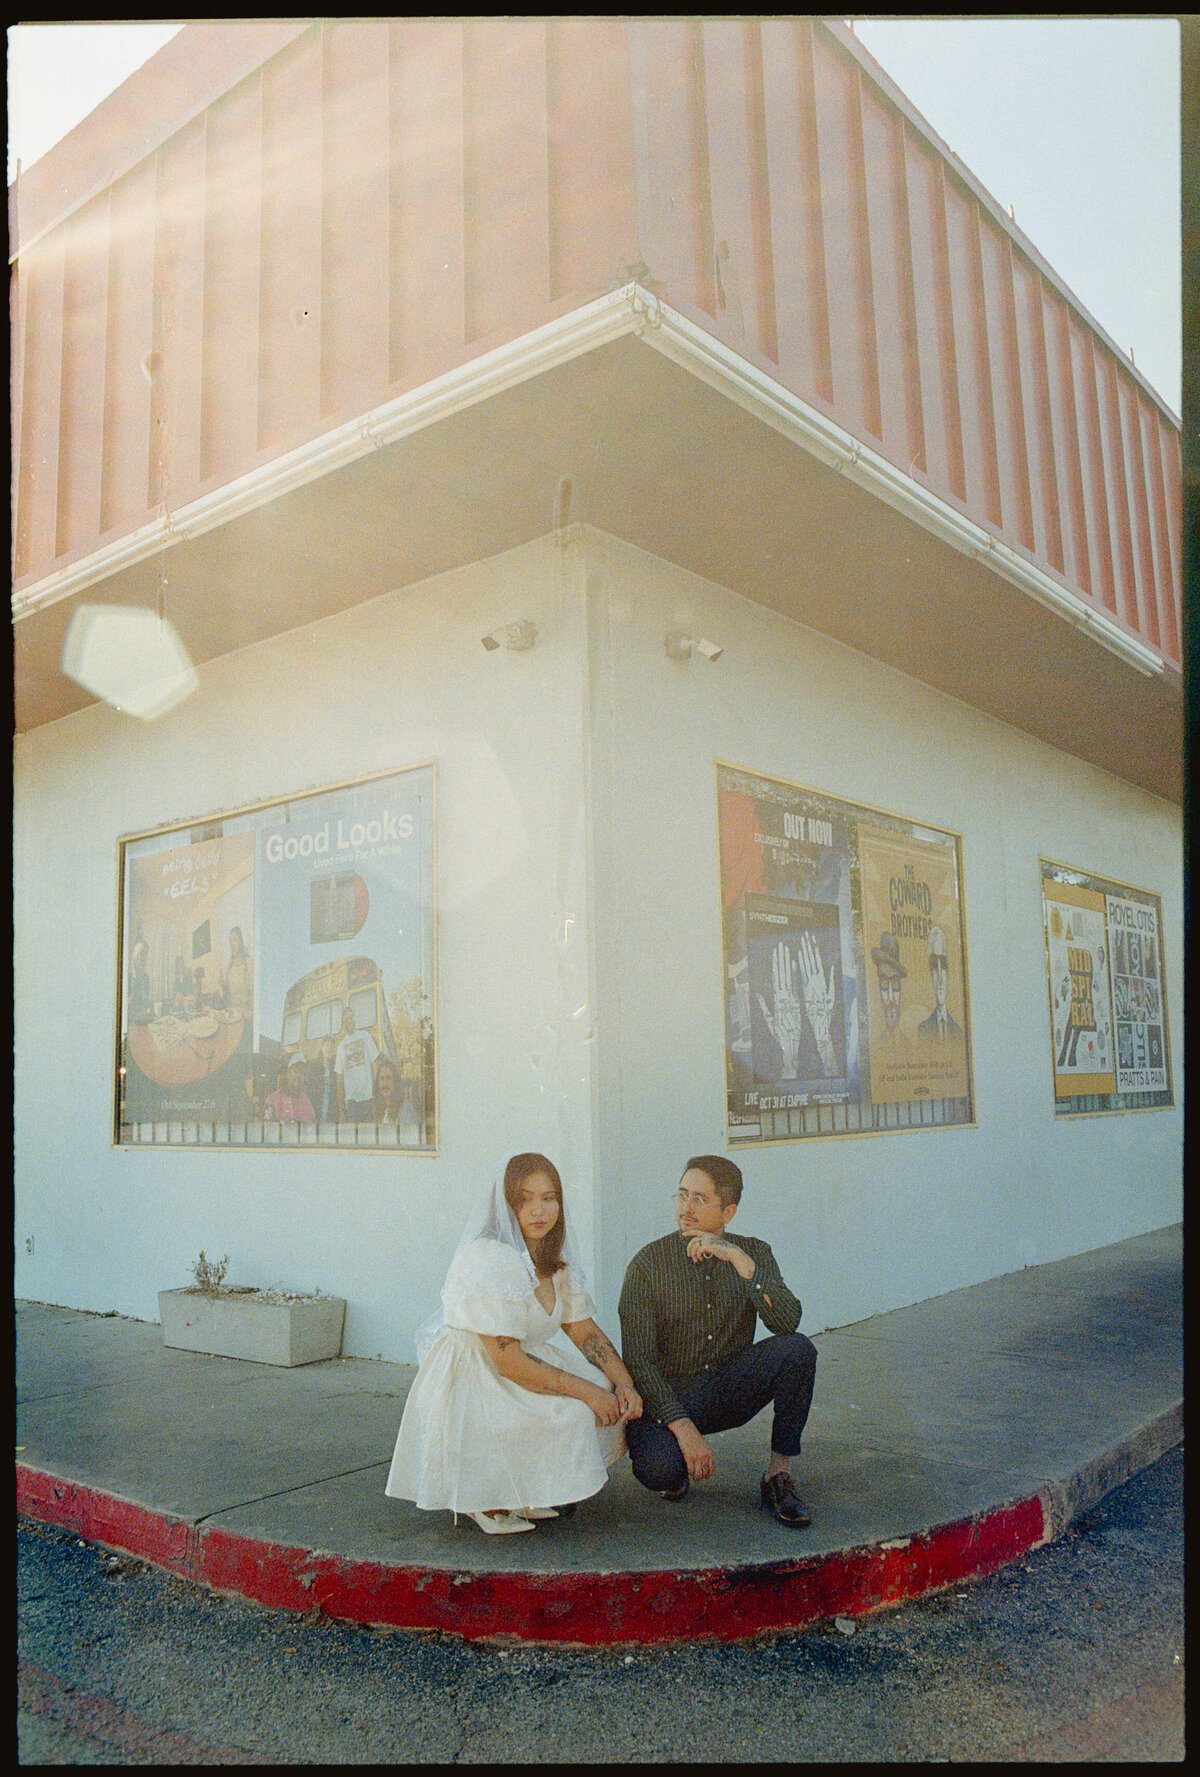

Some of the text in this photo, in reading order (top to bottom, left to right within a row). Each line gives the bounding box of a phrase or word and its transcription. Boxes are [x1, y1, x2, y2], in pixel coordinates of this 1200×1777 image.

[265, 810, 414, 863] Good Looks
[783, 812, 833, 847] OUT NOW
[370, 847, 377, 857] A
[904, 865, 915, 880] THE
[889, 876, 932, 916] COWARD
[891, 912, 933, 940] BROTHERS
[1108, 902, 1155, 933] ROYEL OTIS
[1119, 1070, 1165, 1086] PRATTS & PAIN
[744, 1091, 759, 1106] LIVE
[760, 1096, 772, 1110] OCT
[787, 1093, 809, 1108] EMPIRE
